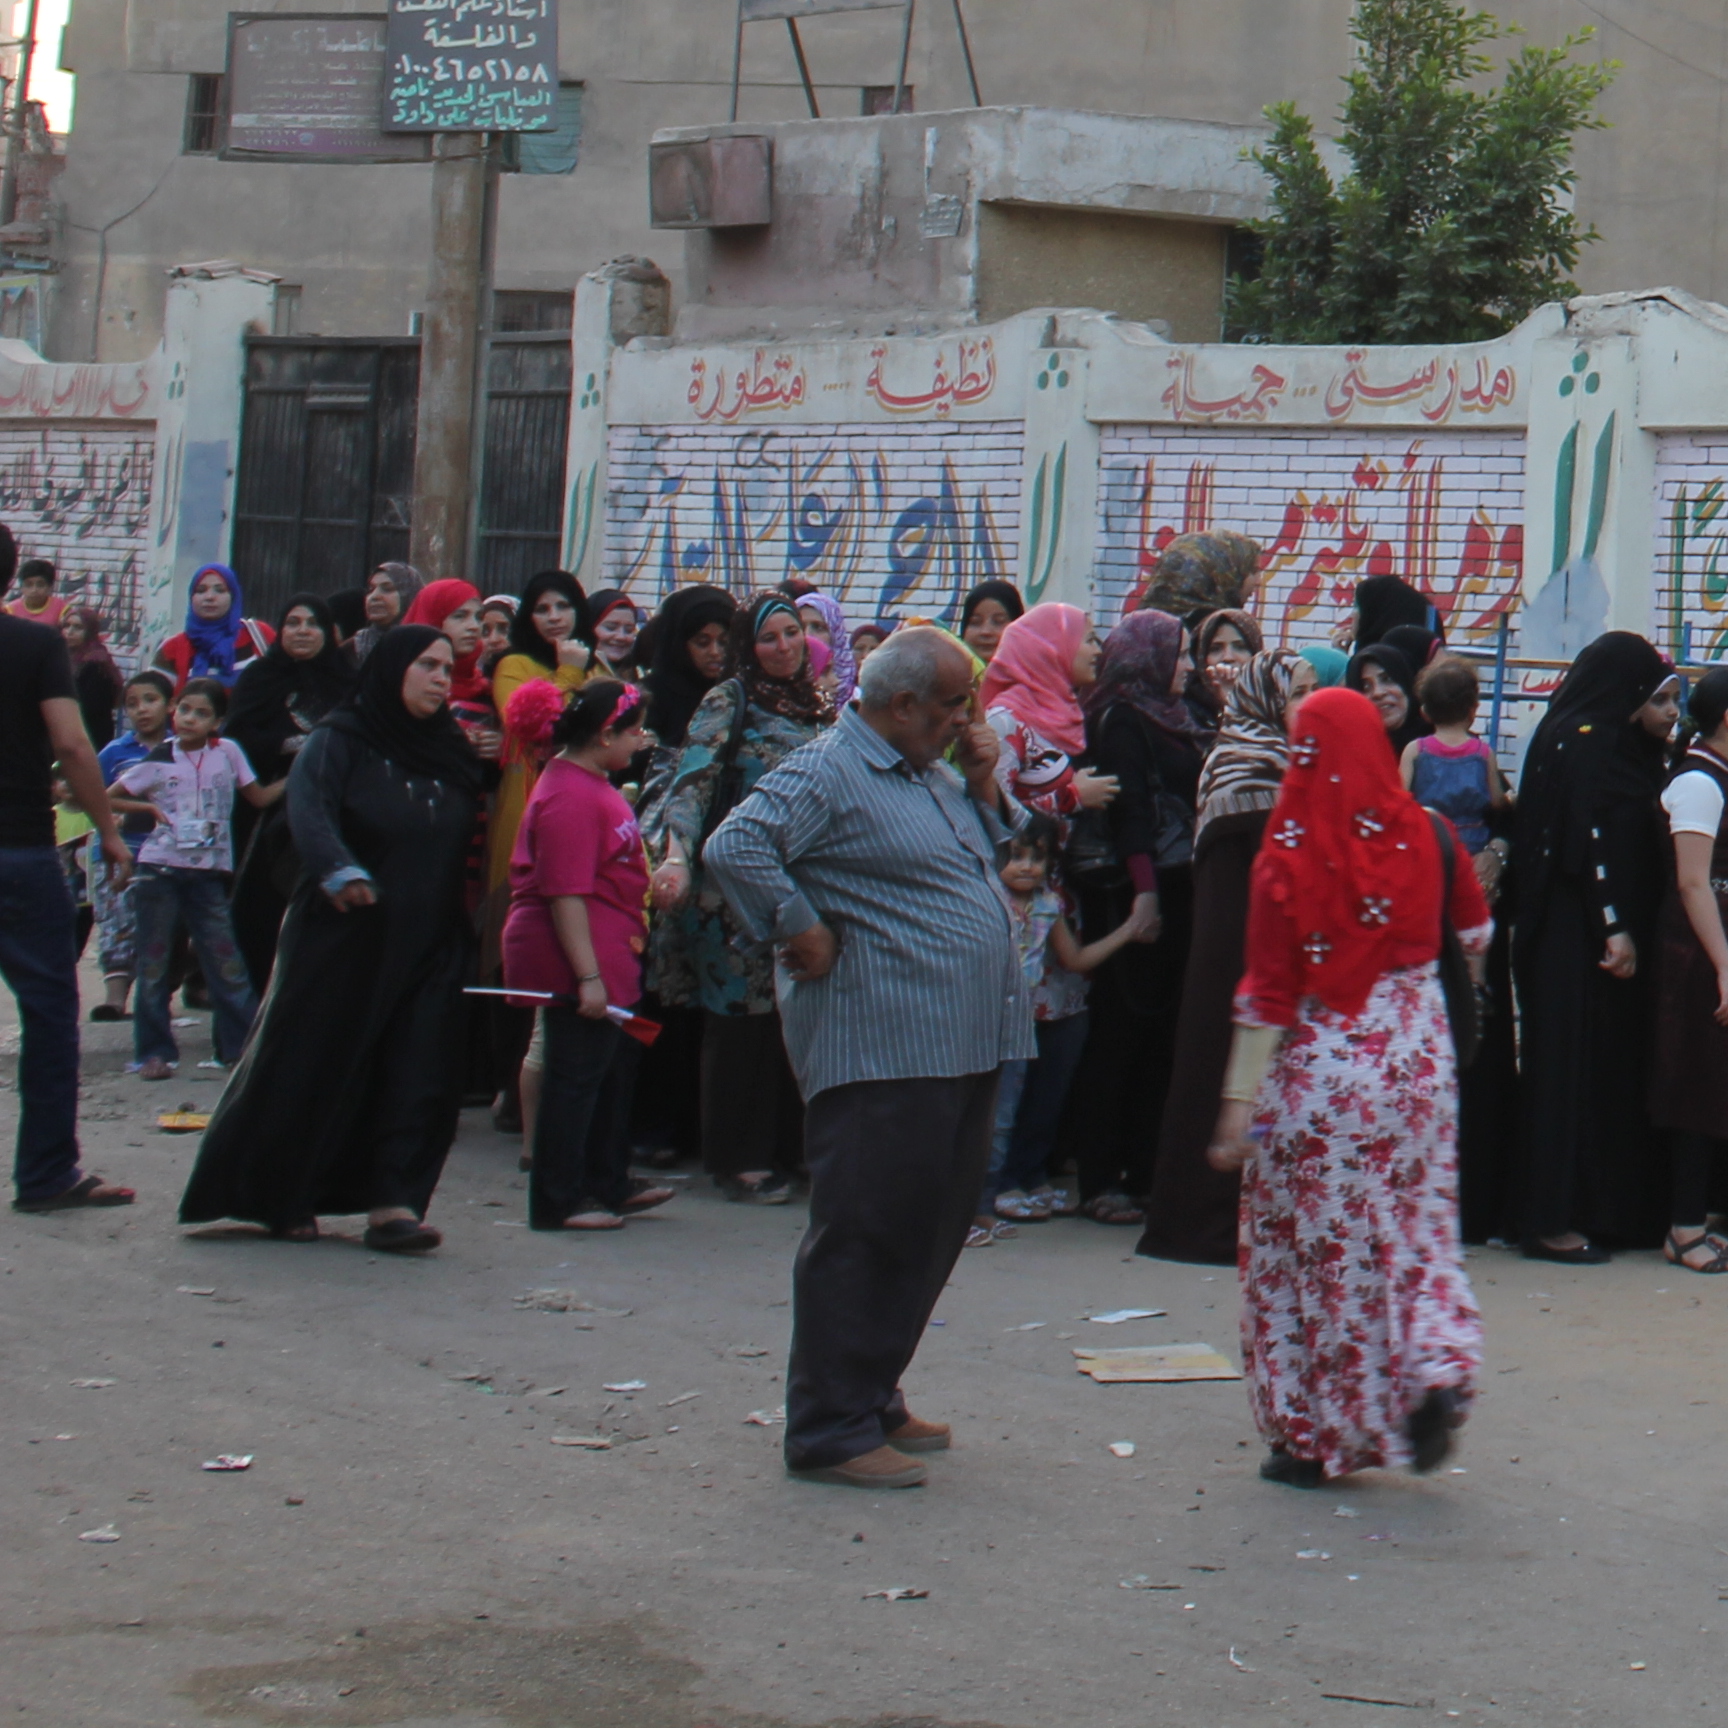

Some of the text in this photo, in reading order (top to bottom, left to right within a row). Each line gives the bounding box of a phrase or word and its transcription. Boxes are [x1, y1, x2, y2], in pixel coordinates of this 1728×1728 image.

[423, 17, 537, 49] والفلسفة
[687, 336, 997, 422] نظيفة متطورة
[1160, 350, 1288, 421] جميلة
